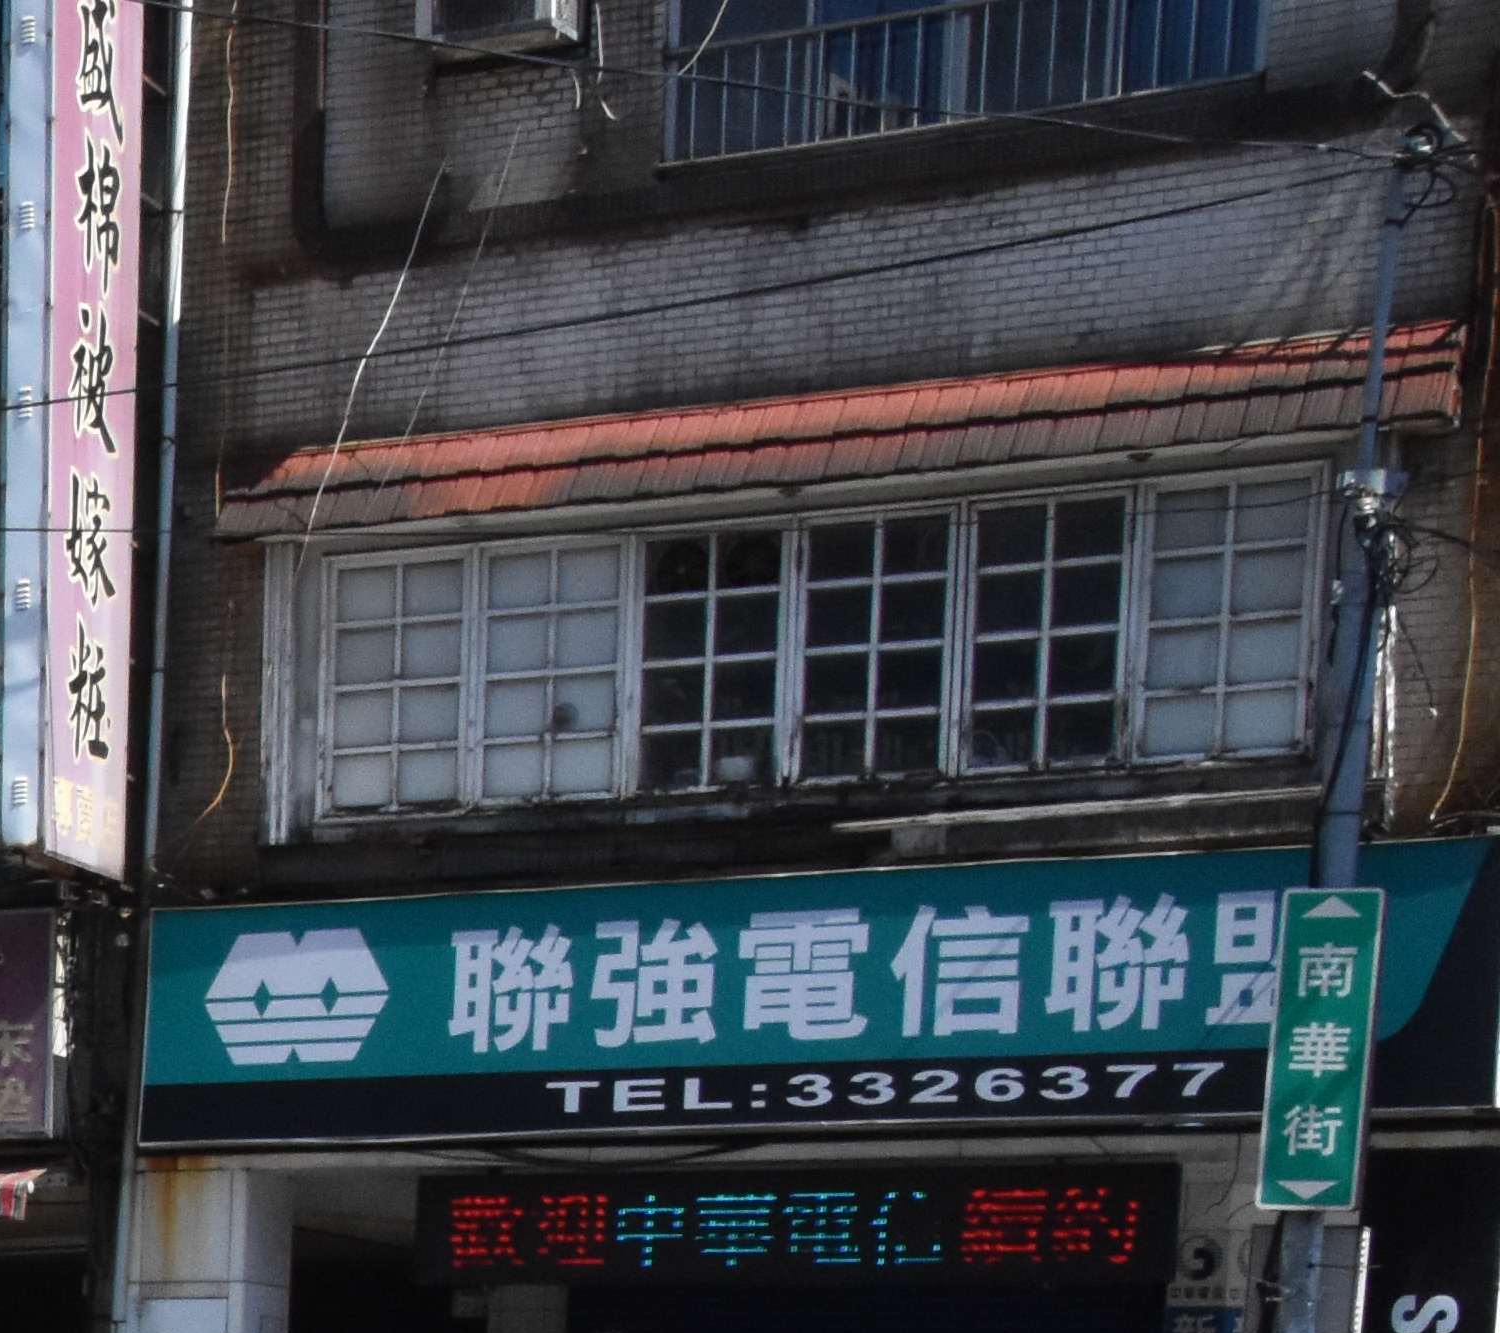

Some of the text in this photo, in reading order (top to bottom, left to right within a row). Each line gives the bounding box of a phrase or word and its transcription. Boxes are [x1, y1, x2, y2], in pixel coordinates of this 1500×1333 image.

[548, 1061, 1225, 1114] TEL:3326377
[1284, 942, 1357, 1156] 南華街
